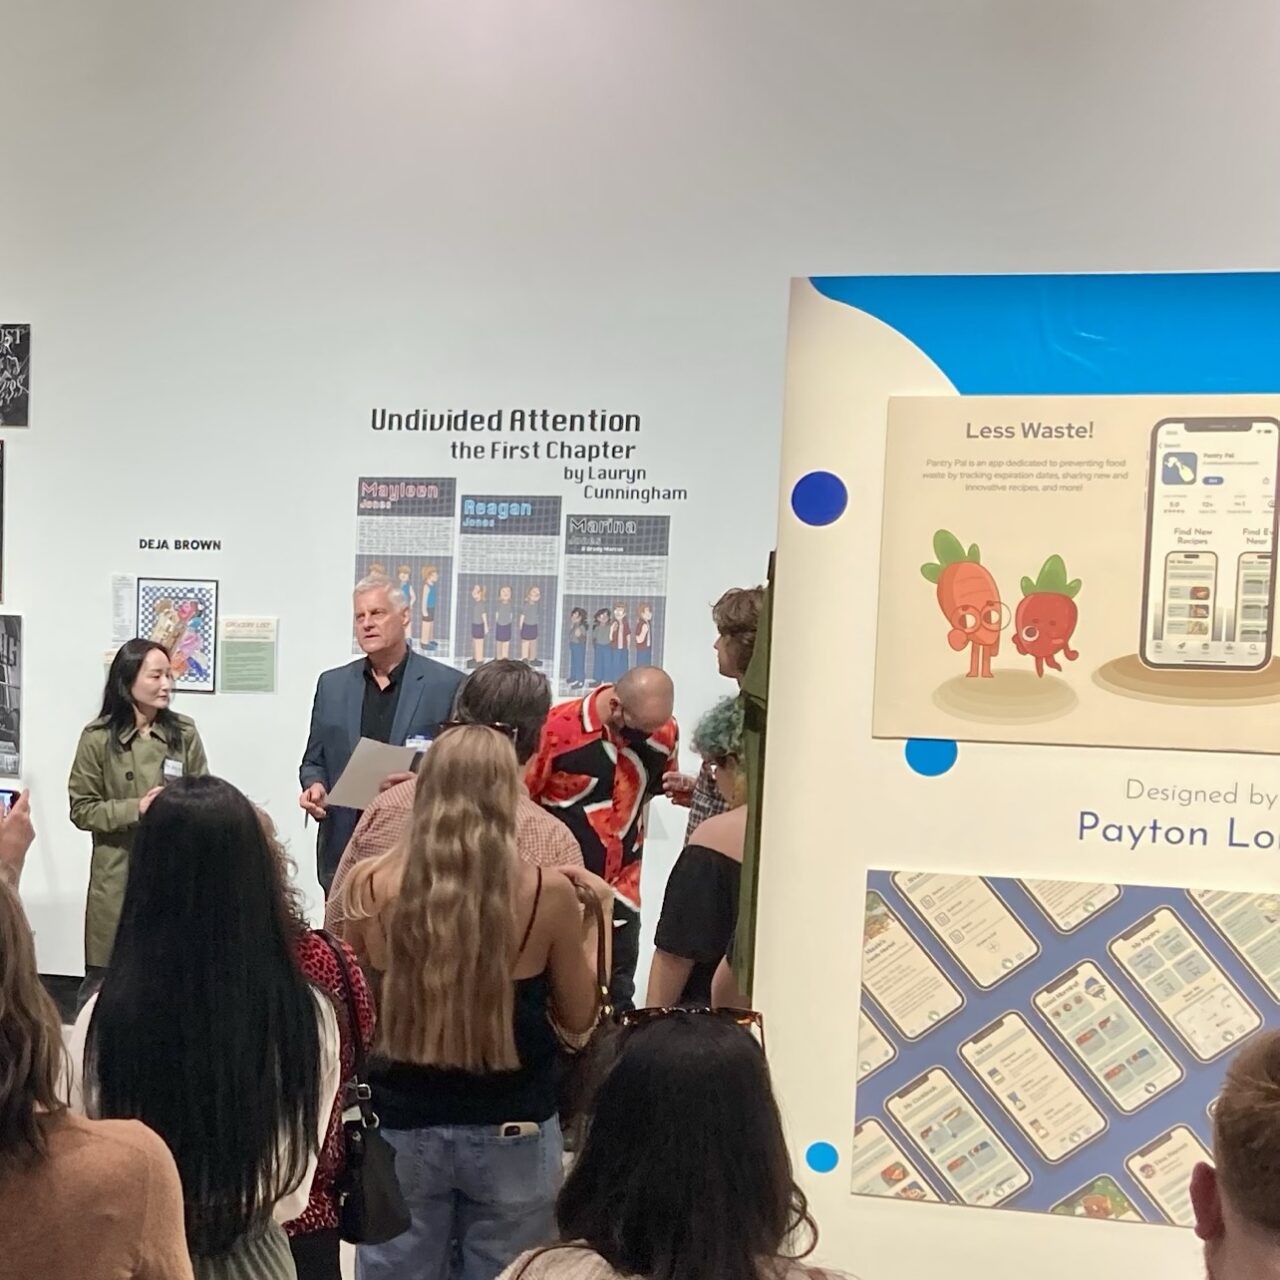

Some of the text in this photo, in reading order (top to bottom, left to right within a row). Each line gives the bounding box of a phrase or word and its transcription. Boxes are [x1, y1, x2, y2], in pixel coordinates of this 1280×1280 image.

[371, 408, 642, 433] Undivided Attention
[966, 421, 1094, 439] Less Waste!
[451, 441, 636, 463] the First Chapter
[564, 466, 646, 484] by Lauryn
[583, 485, 688, 503] Cunningham
[463, 499, 532, 519] Reagan
[569, 517, 637, 534] Marina
[1173, 528, 1213, 536] Find New
[1242, 528, 1261, 536] Find
[139, 538, 221, 550] DEJA BROWN
[1177, 537, 1208, 545] Recipes
[1126, 778, 1279, 810] Designed by
[1079, 811, 1280, 850] Payton Lo
